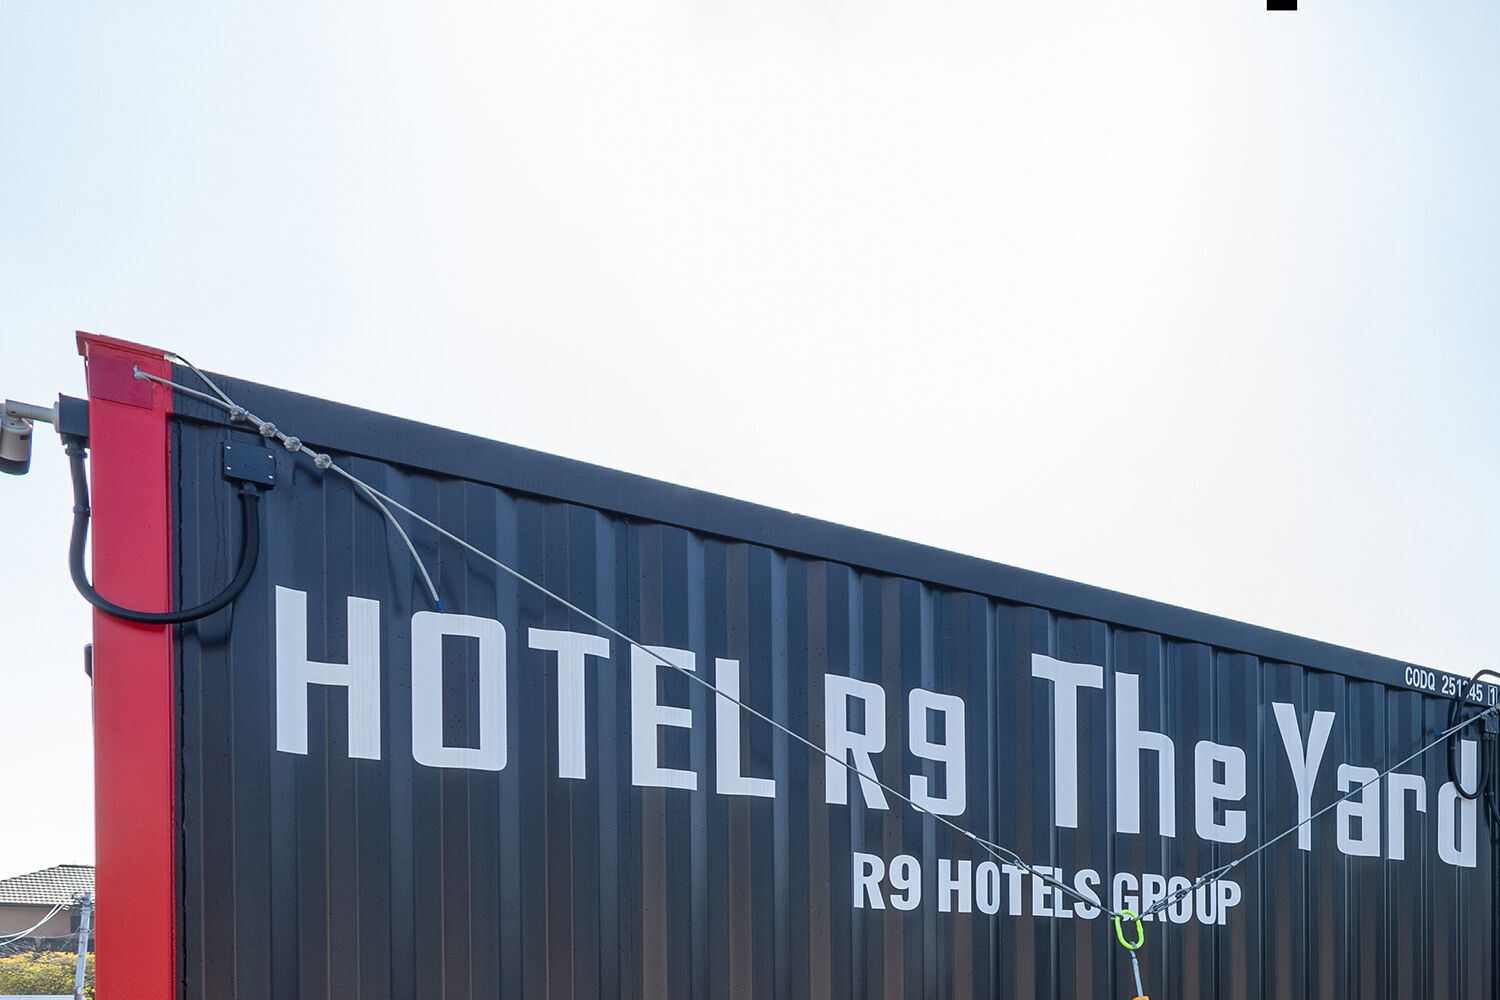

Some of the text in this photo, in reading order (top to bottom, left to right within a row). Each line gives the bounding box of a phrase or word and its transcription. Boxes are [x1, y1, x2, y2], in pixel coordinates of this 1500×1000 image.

[1405, 666, 1436, 691] CODQ
[275, 585, 1478, 868] HOTEL R9 The Yard
[853, 851, 1242, 926] R9 HOTELS GROUP
